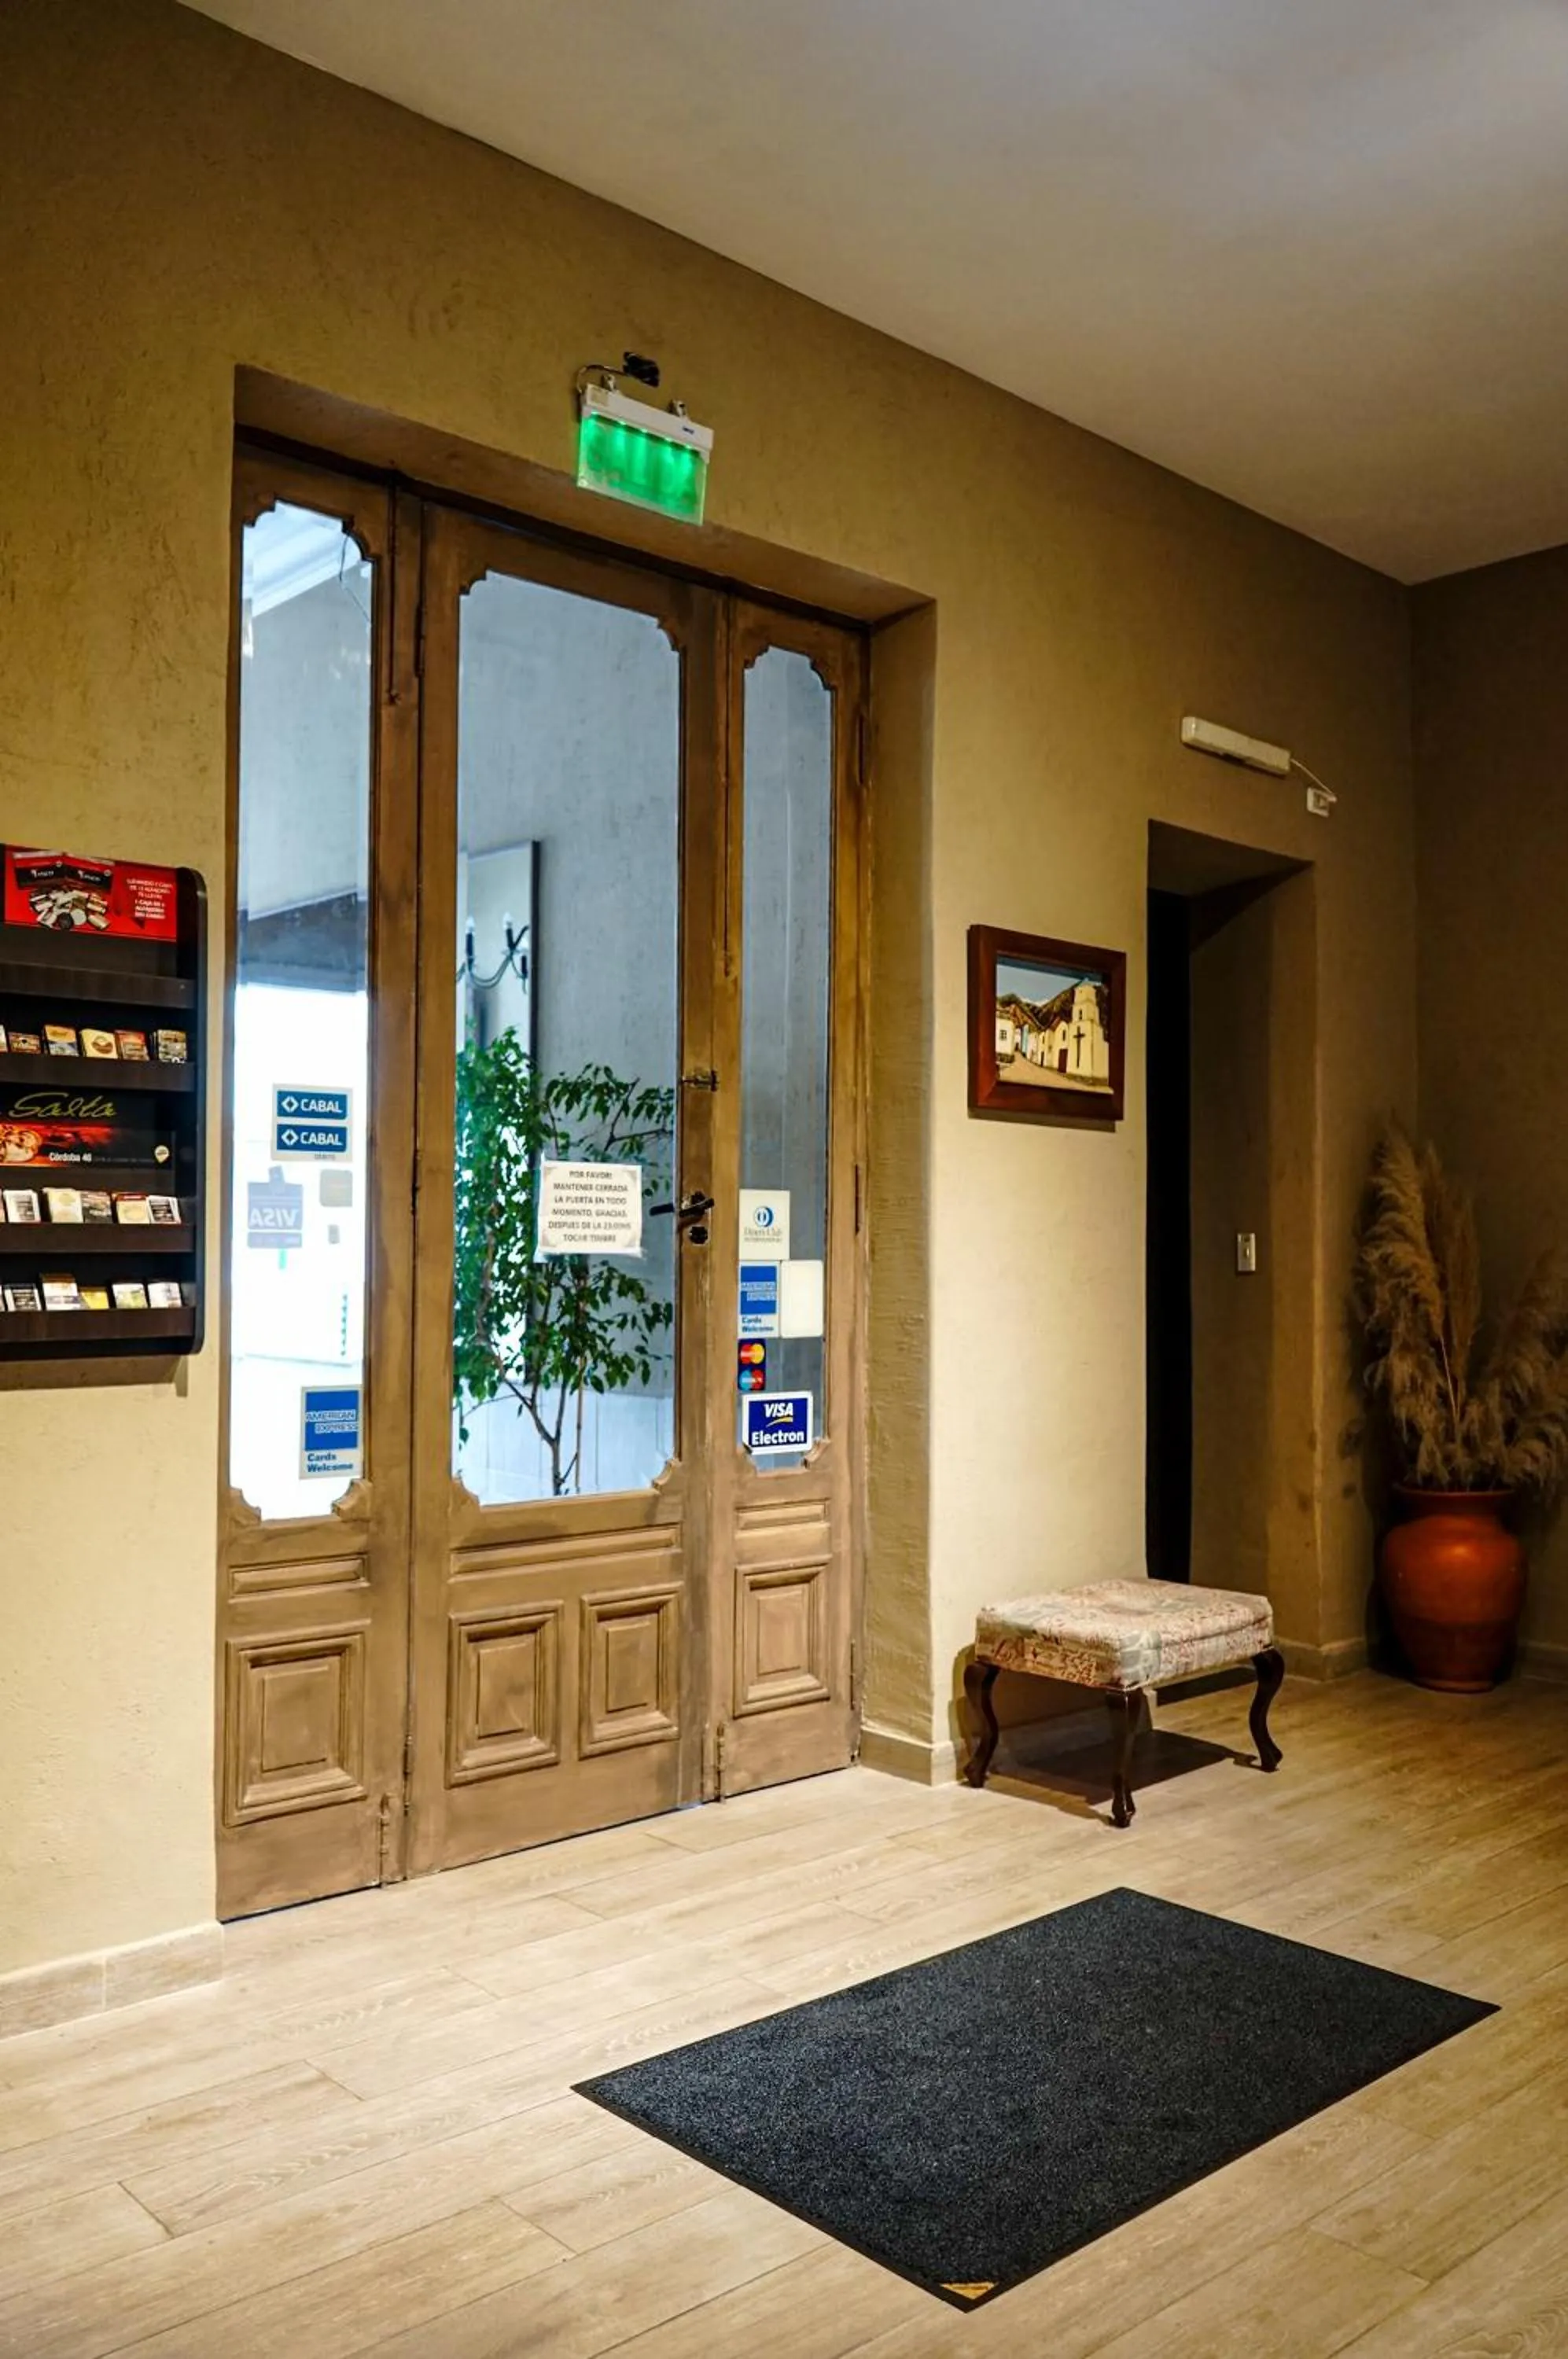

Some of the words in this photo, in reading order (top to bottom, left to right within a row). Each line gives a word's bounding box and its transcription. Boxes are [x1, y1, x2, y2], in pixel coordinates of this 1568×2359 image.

[9, 1091, 116, 1117] Salta
[300, 1099, 343, 1113] CABAL
[300, 1132, 343, 1146] CABAL
[569, 1170, 584, 1179] POR
[553, 1183, 593, 1191] MANTENER
[594, 1183, 628, 1193] CERRADA
[554, 1195, 564, 1204] LA
[606, 1197, 628, 1205] TODO
[764, 1402, 793, 1418] VISA
[751, 1430, 804, 1445] Electron
[307, 1452, 337, 1462] Cards
[307, 1463, 353, 1473] Welcome
